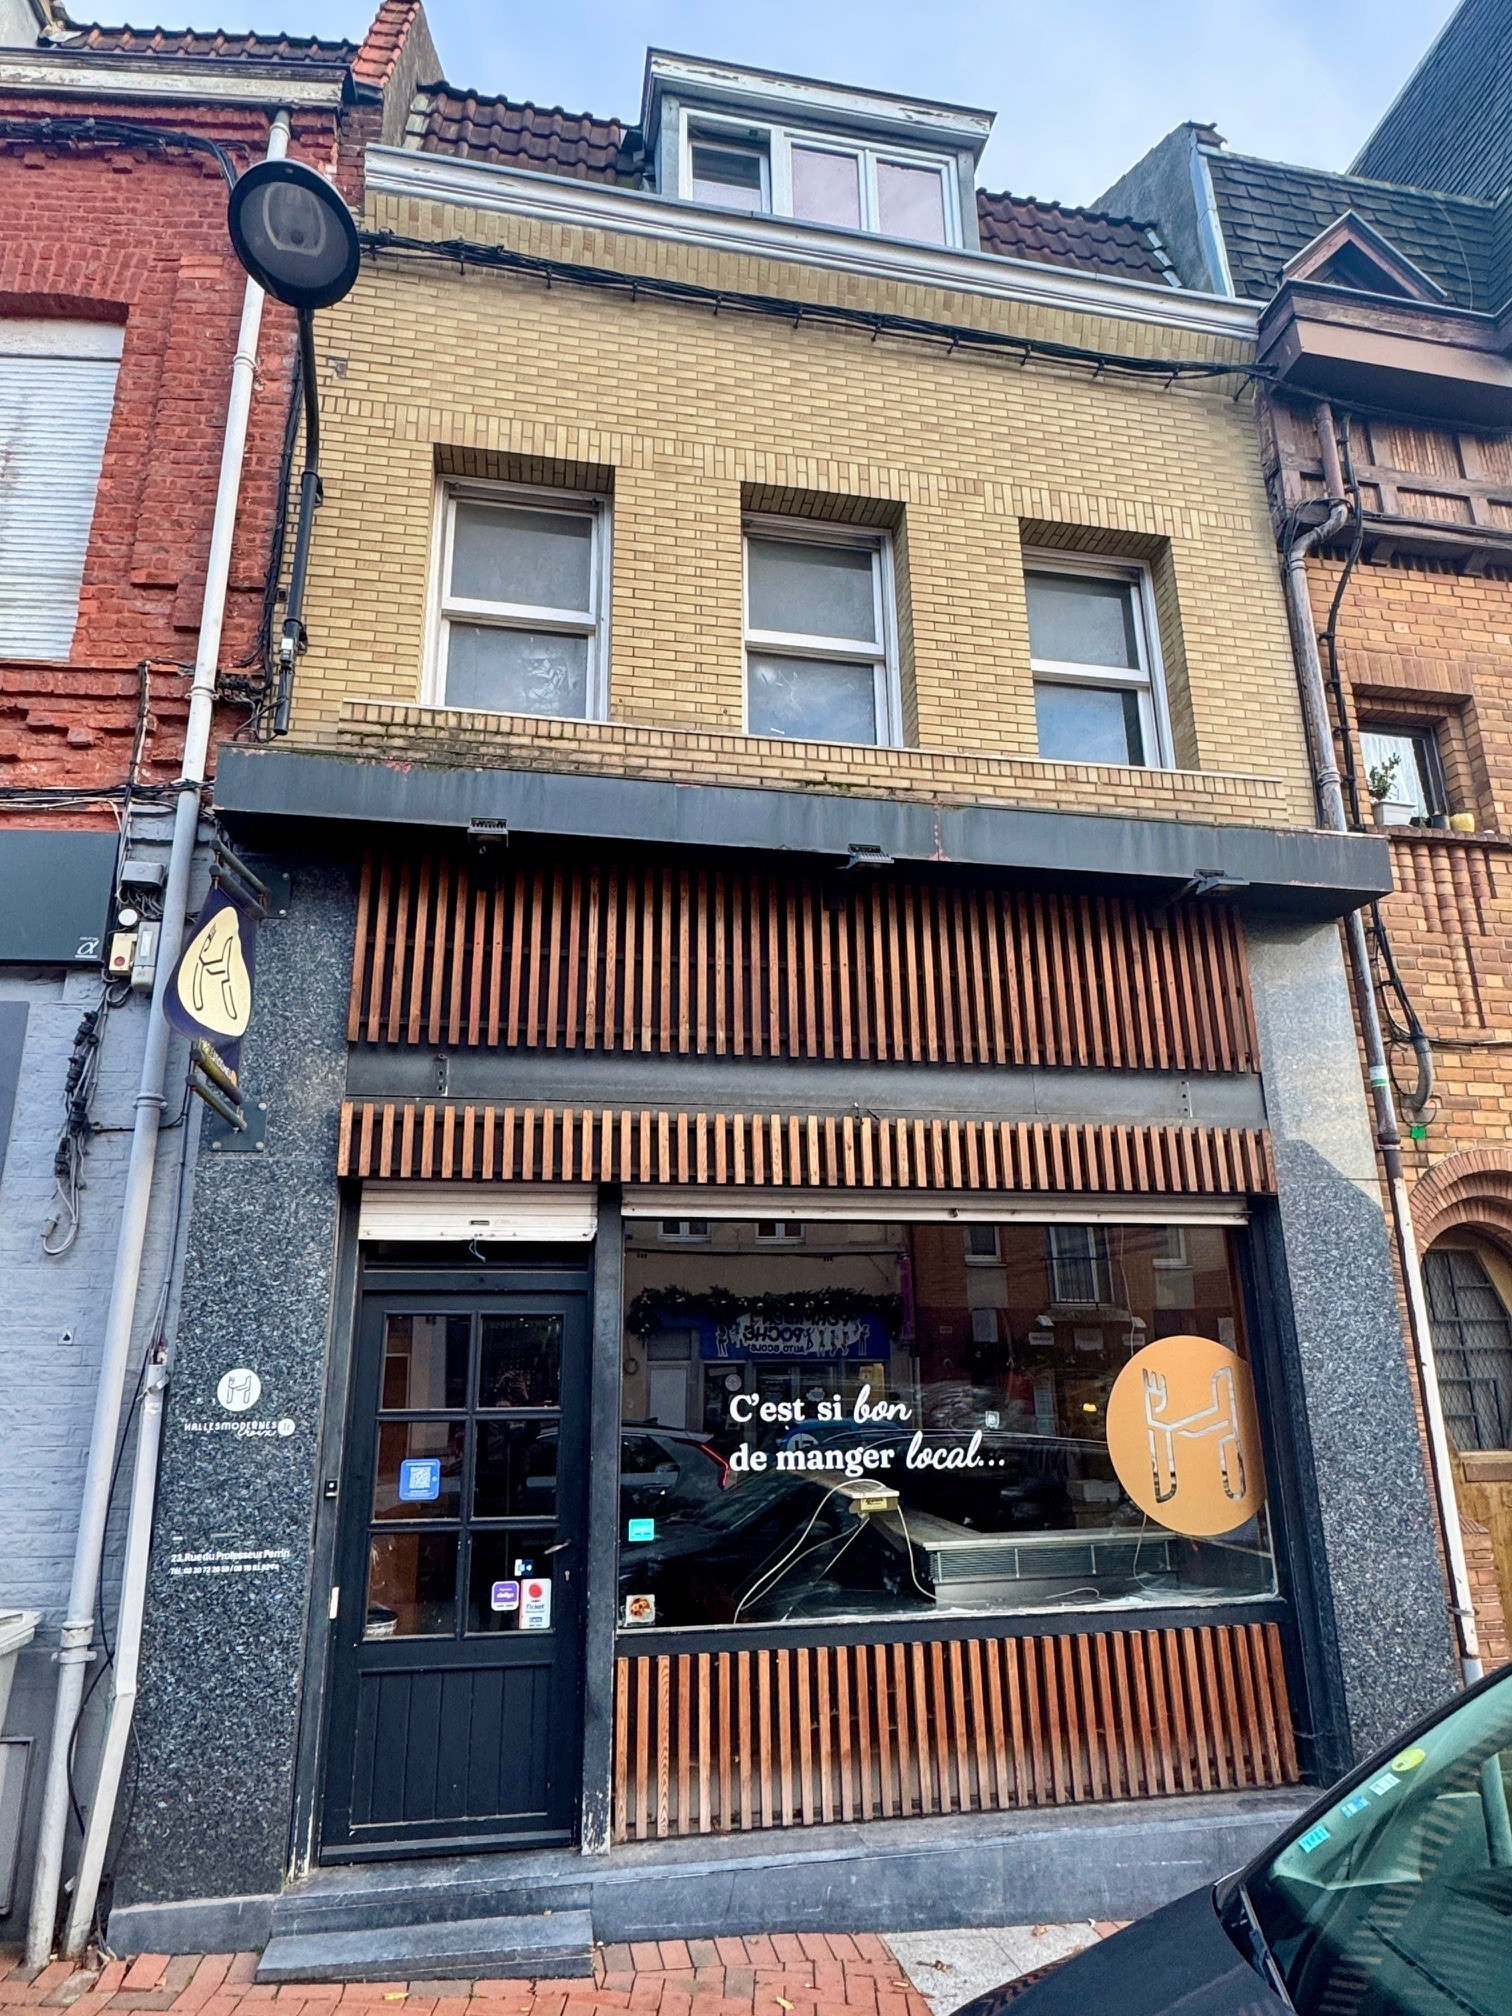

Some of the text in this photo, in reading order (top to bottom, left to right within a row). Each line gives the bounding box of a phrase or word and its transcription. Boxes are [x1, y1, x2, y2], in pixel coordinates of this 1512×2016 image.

[730, 1384, 912, 1423] C’est si bon
[729, 1443, 767, 1471] de
[776, 1446, 895, 1478] manger
[906, 1430, 1005, 1470] local...
[185, 1552, 202, 1561] Rue
[202, 1551, 215, 1561] du
